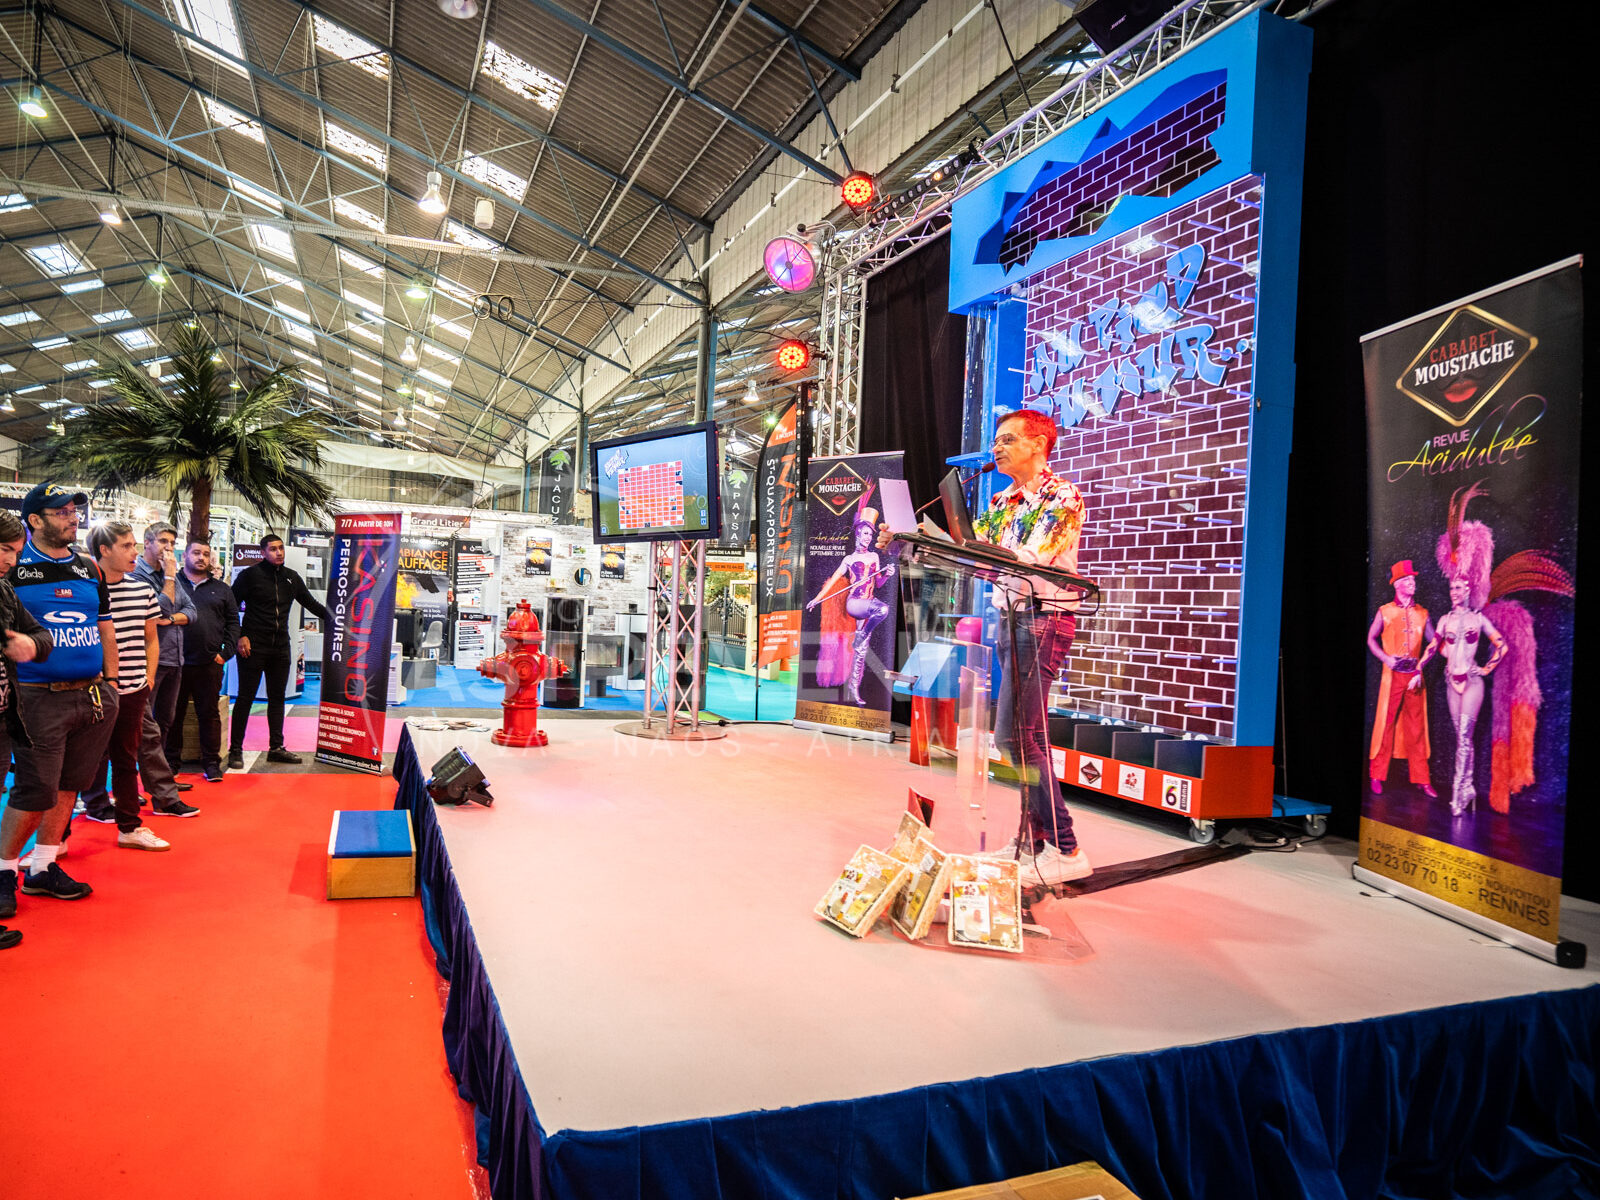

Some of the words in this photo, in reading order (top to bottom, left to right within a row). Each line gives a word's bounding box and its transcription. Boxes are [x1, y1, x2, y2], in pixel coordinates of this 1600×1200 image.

[1430, 329, 1498, 364] CABARET
[1414, 340, 1515, 387] MOUSTACHE
[1433, 429, 1470, 449] REVUE
[818, 483, 862, 493] MOUSTACHE
[825, 476, 855, 485] CABARET
[341, 519, 353, 528] 7/7
[411, 516, 438, 526] Grand
[440, 518, 464, 528] Litier
[332, 538, 351, 662] PERROS-GUIREC
[1166, 785, 1177, 806] 6
[1367, 847, 1381, 863] 02
[1384, 854, 1398, 870] 23
[1402, 860, 1417, 876] 07
[1422, 867, 1437, 884] 70
[1443, 875, 1458, 892] 18
[1479, 887, 1549, 926] RENNES
